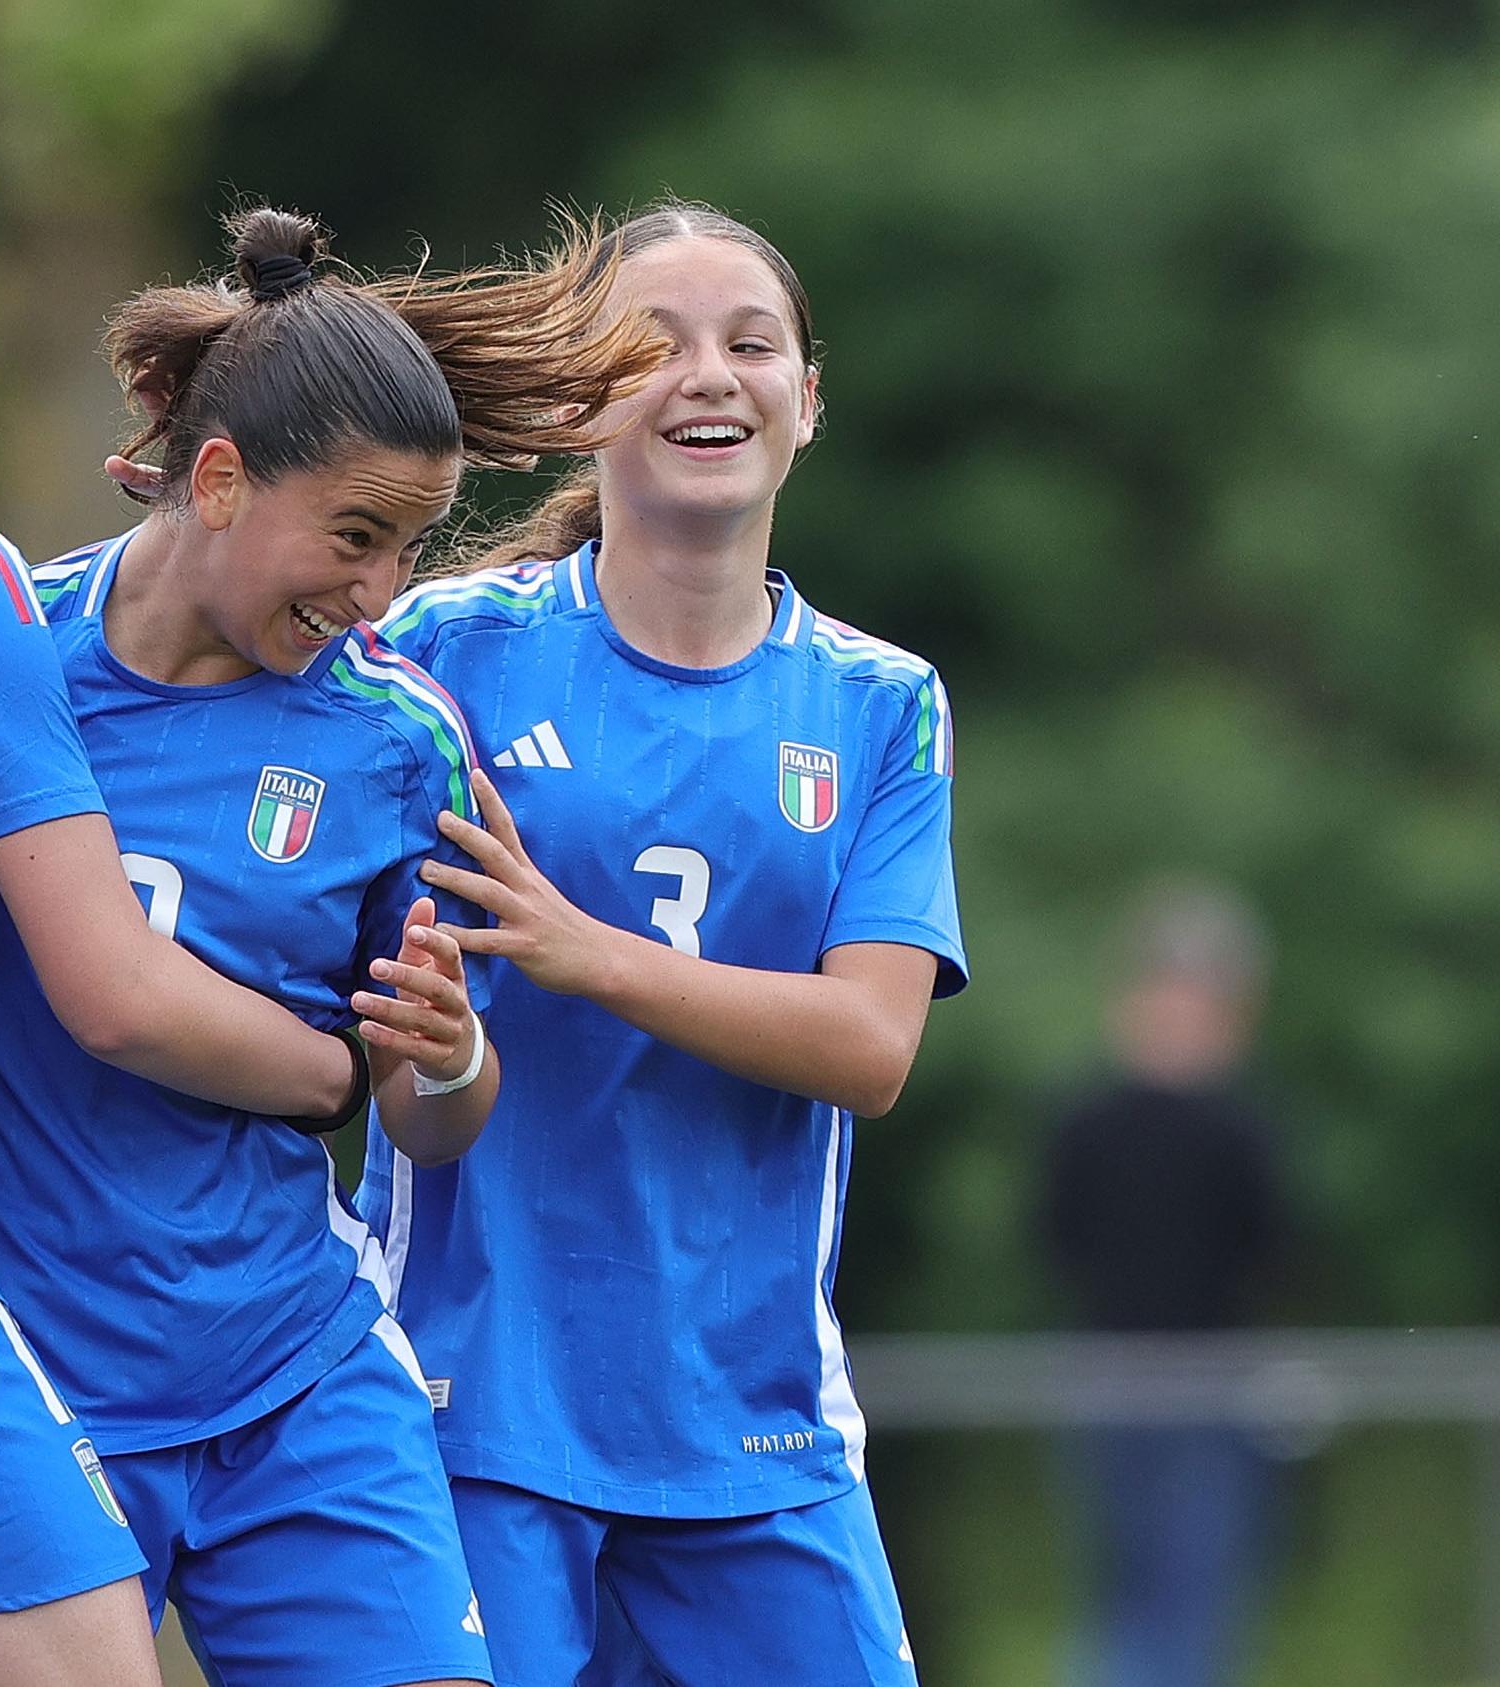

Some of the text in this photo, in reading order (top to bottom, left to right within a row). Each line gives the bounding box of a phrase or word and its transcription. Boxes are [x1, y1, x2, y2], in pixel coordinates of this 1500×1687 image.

[784, 747, 832, 773] ITALIA
[263, 772, 315, 803] ITALIA
[633, 845, 711, 959] 3
[742, 1431, 813, 1453] HEAT.RDY
